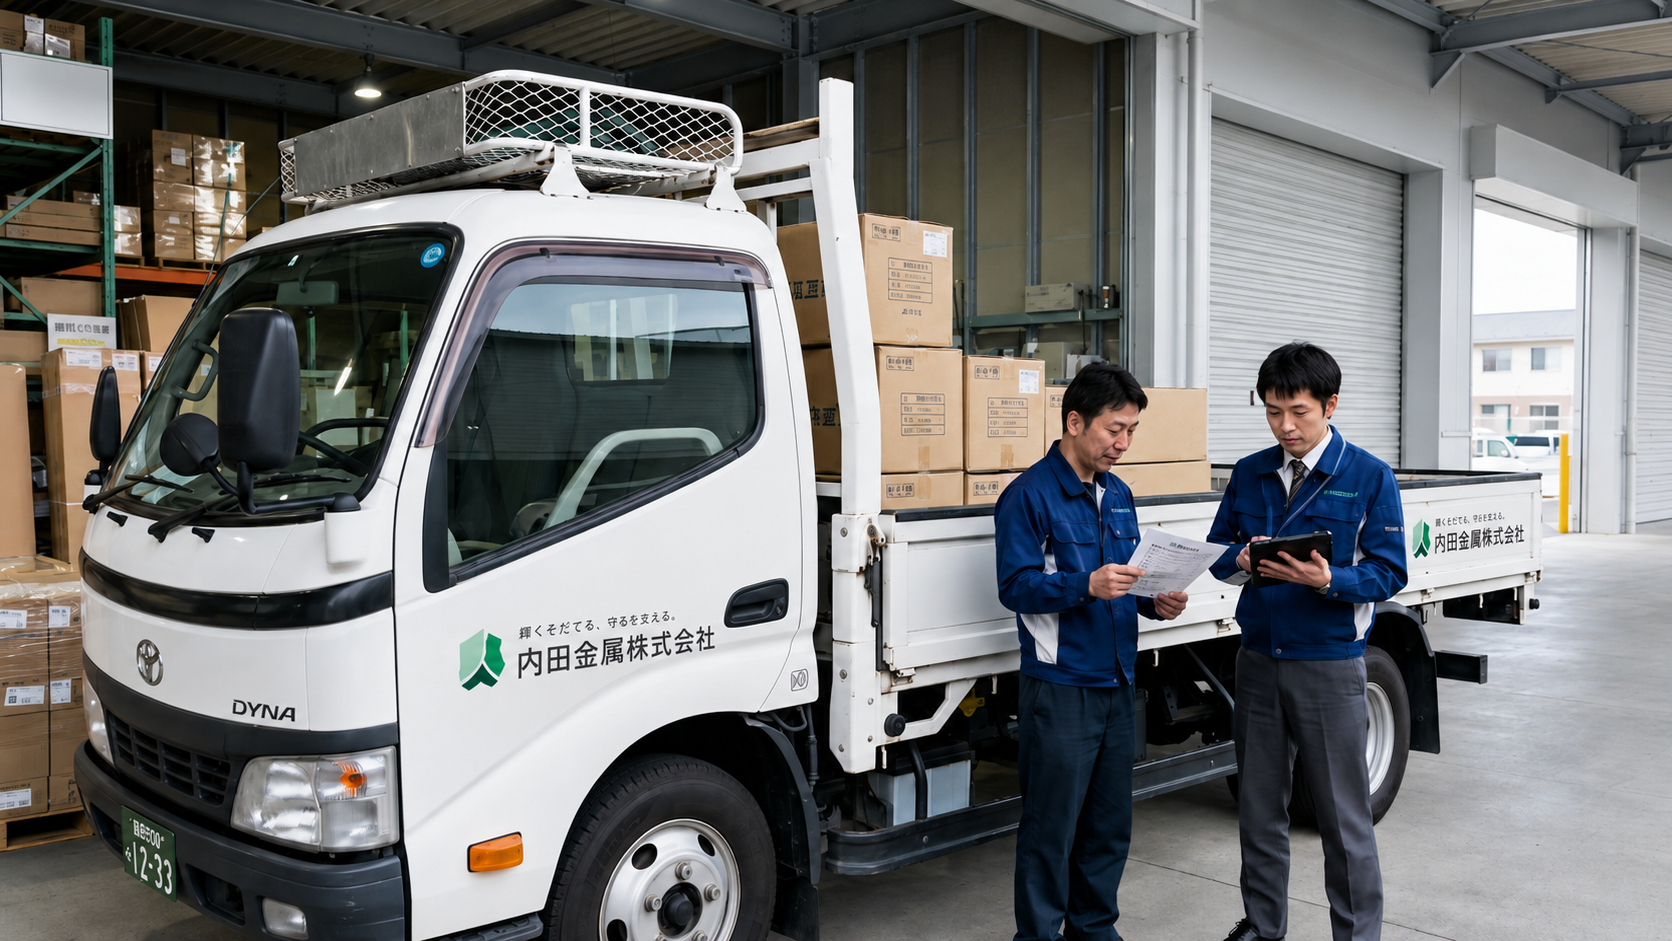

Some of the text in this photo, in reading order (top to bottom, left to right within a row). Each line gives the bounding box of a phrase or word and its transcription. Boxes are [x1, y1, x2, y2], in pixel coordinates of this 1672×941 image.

[518, 625, 715, 679] 内田金属株式会社
[232, 699, 295, 722] DYNA
[132, 841, 173, 895] 12-33
